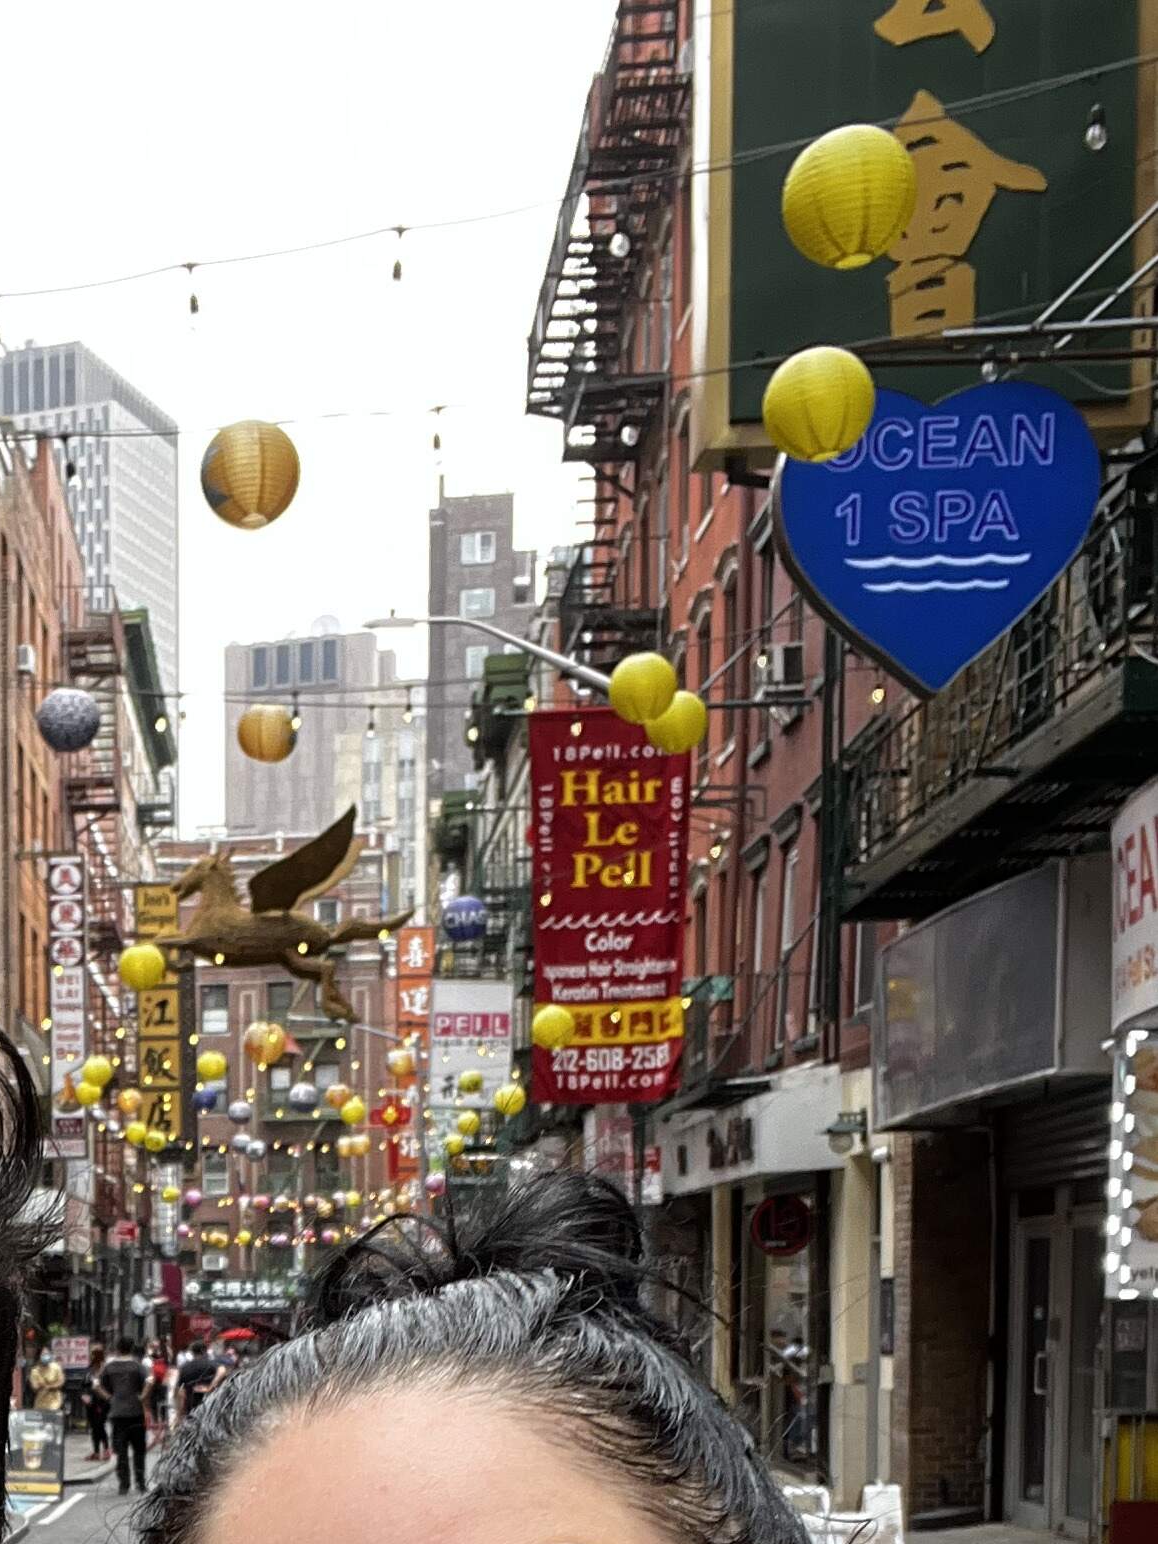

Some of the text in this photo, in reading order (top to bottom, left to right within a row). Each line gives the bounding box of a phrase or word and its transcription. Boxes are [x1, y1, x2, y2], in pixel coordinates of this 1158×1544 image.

[835, 489, 1020, 546] 1 SPA
[553, 744, 670, 762] 18Pell.co
[560, 770, 663, 806] Hair
[583, 811, 639, 847] Le
[570, 850, 653, 888] Pell
[585, 931, 633, 952] Color
[436, 1015, 508, 1036] PELL
